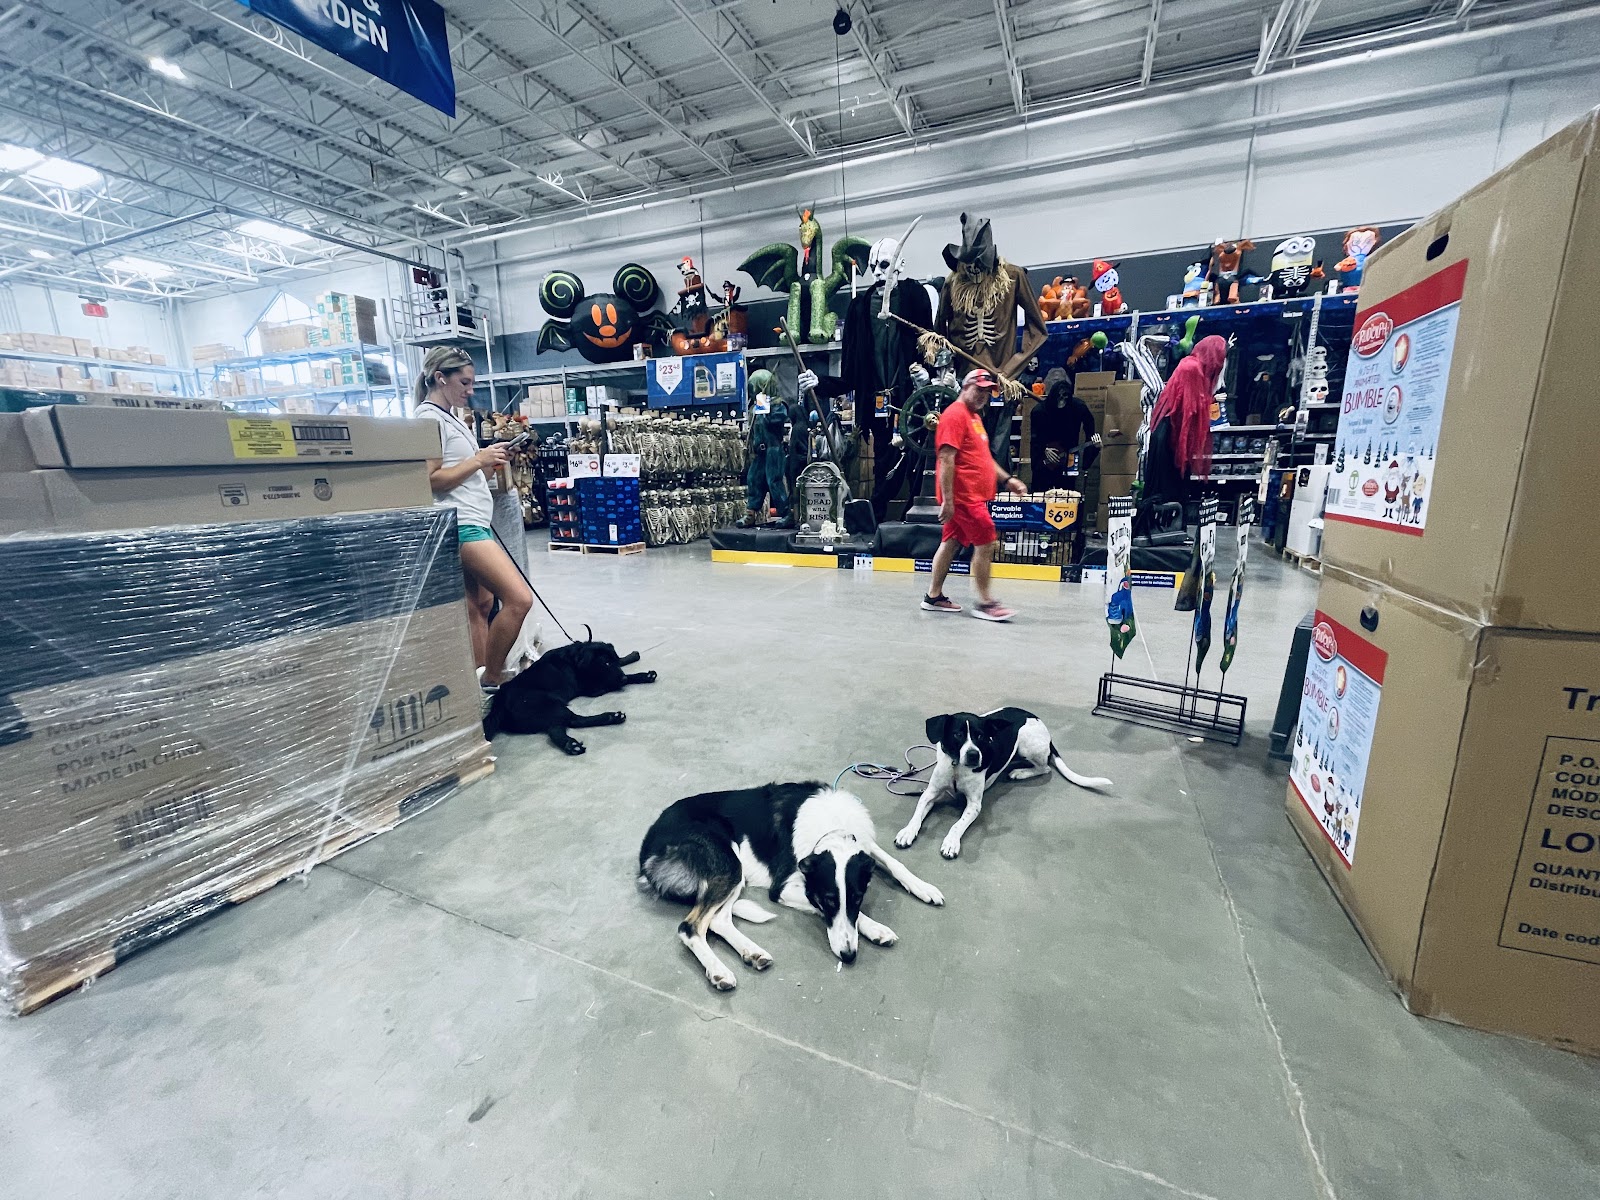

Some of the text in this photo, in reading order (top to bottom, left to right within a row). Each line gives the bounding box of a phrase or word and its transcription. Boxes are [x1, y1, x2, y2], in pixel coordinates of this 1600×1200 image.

[1343, 387, 1385, 415] BUMBLE
[991, 504, 1022, 512] Carvable
[991, 511, 1024, 520] Pumpkins
[1303, 677, 1330, 713] BUMBLE
[1562, 686, 1600, 712] Tr
[61, 741, 207, 794] MADE IN CHINA
[1556, 771, 1600, 786] COU
[1552, 787, 1600, 803] MOD
[1547, 803, 1600, 820] DESC
[1541, 828, 1600, 853] LO
[1518, 922, 1559, 939] Date
